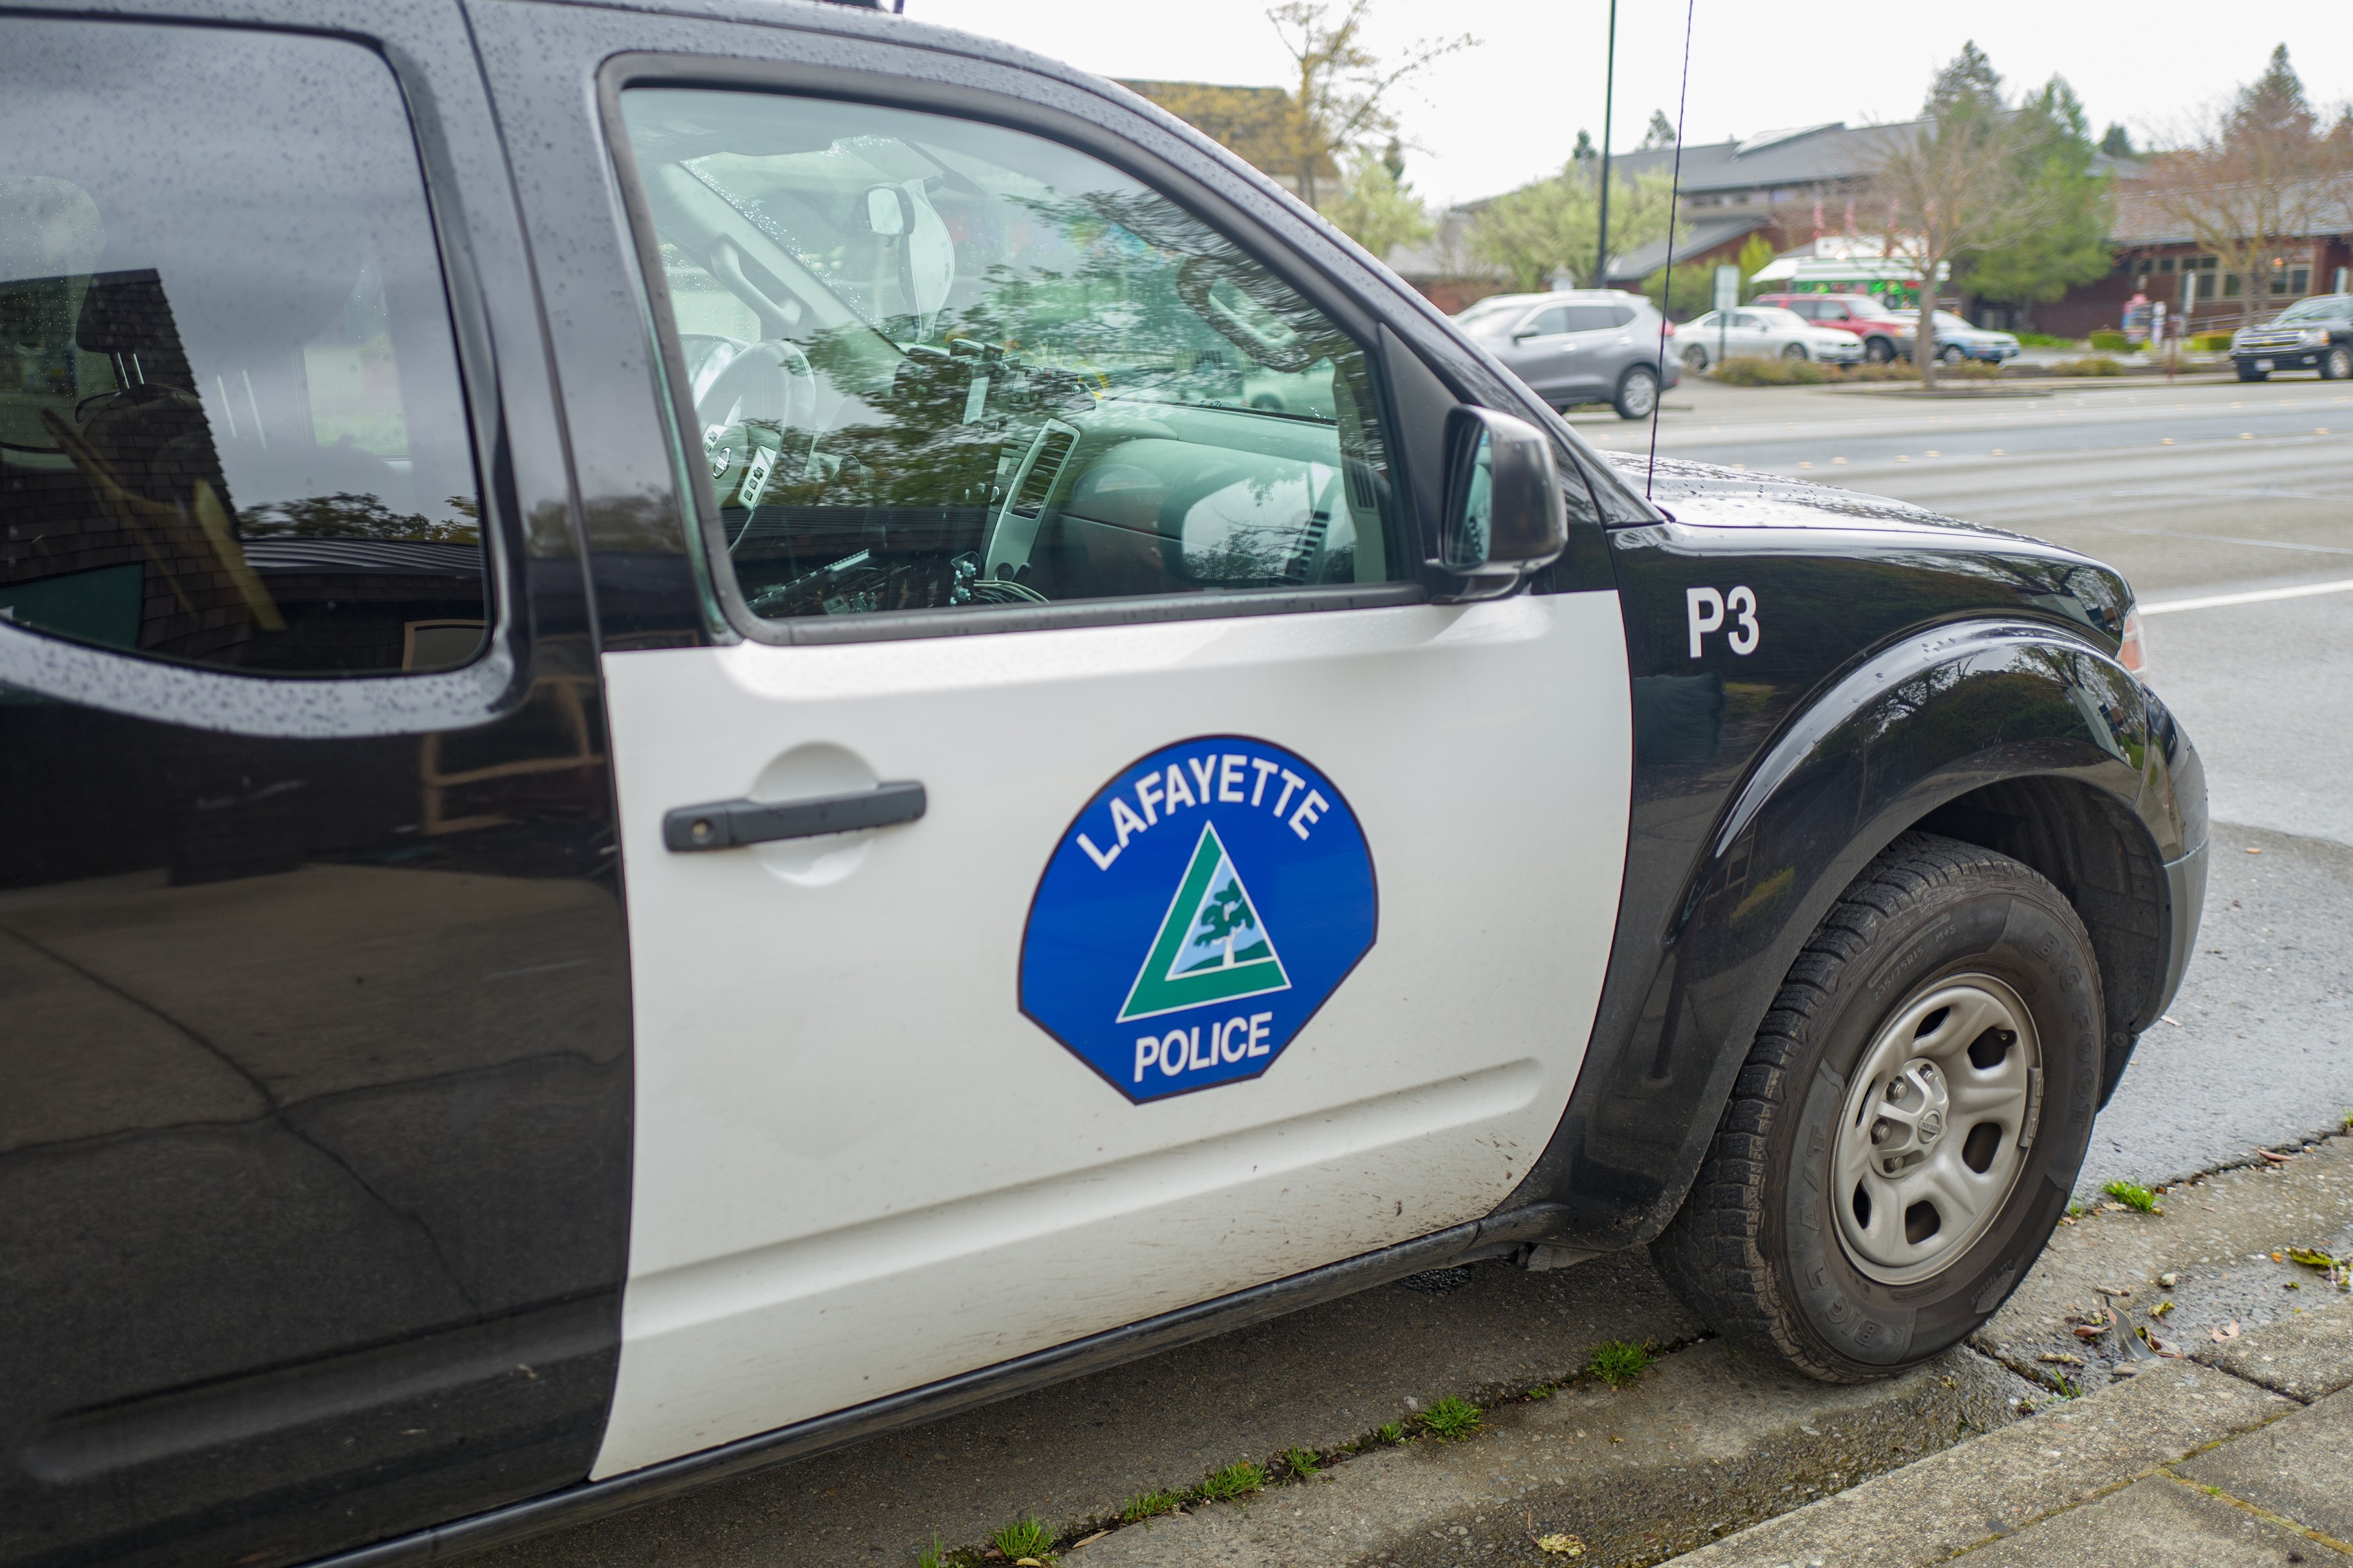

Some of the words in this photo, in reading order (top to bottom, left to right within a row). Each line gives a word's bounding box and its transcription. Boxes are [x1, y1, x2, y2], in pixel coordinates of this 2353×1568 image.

[1686, 585, 1760, 659] P3
[1076, 753, 1330, 872] LAFAYETTE
[1873, 945, 1924, 1002] 235/75R15
[1934, 924, 1956, 943] M+S
[1133, 1010, 1273, 1082] POLICE
[2033, 931, 2082, 994] BIG
[2073, 1003, 2096, 1131] FOOT
[1799, 1125, 1826, 1232] A/T
[1824, 1294, 1884, 1349] BIG
